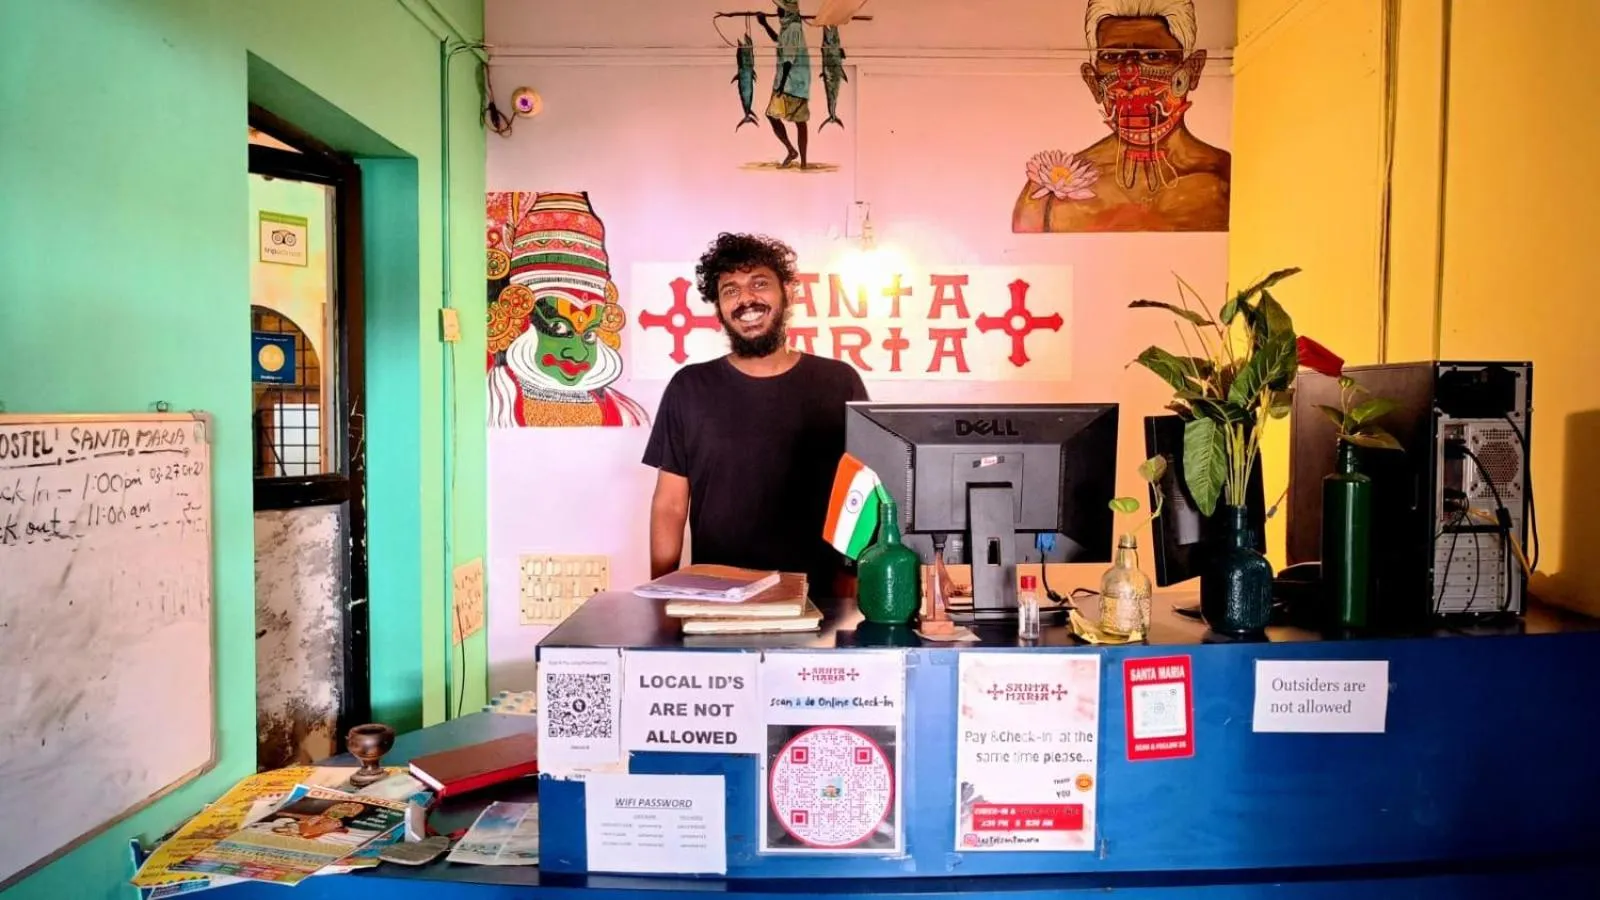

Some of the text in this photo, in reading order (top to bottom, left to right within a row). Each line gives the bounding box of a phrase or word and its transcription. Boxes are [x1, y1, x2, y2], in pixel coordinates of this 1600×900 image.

[785, 273, 971, 319] ANTA
[786, 326, 971, 372] ARIA
[955, 419, 1019, 436] DELL
[71, 427, 130, 451] SANTA
[136, 428, 185, 448] MARIA
[1130, 665, 1185, 682] SANTA MARIA
[639, 675, 745, 690] LOCAL ID'S
[1005, 683, 1049, 692] SANTA
[1271, 677, 1366, 692] Outsiders are
[818, 696, 849, 708] Online
[1005, 692, 1049, 701] MARIA
[649, 702, 735, 717] ARE NOT
[1270, 699, 1352, 713] not allowed
[646, 730, 738, 745] ALLOWED
[964, 731, 987, 744] Pay
[1058, 732, 1071, 742] at
[1074, 731, 1094, 743] the
[976, 752, 1010, 763] same
[615, 798, 693, 809] WIFI PASSWORD
